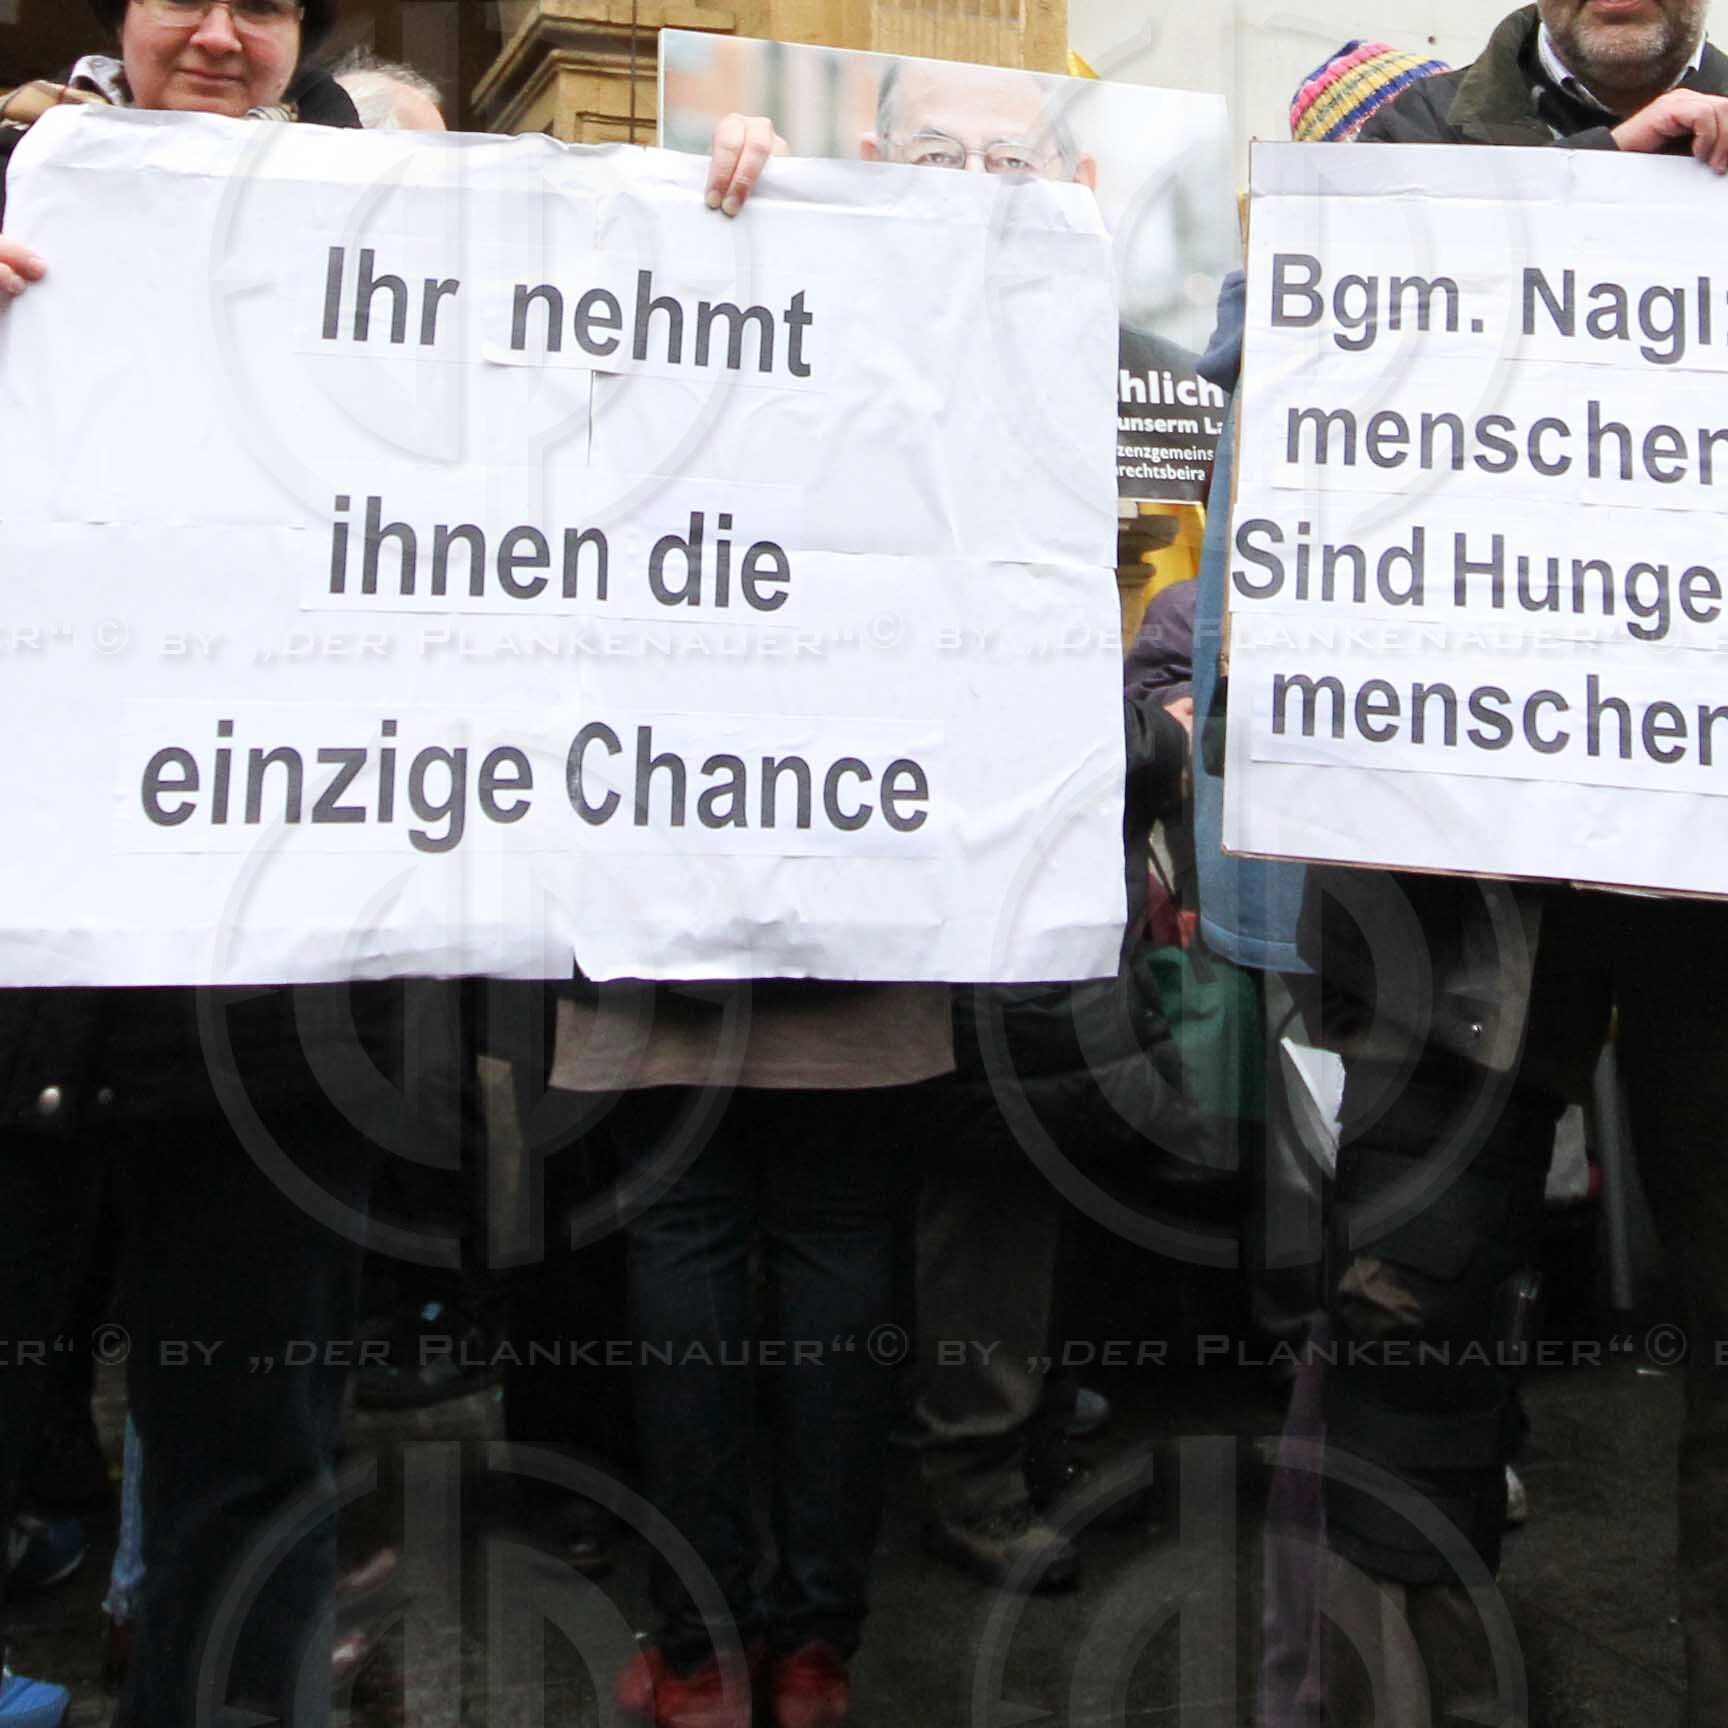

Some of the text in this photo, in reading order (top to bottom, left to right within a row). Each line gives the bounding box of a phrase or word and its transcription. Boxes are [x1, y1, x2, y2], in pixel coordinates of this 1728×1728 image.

[322, 246, 813, 378] Ihr nehmt
[1270, 254, 1484, 350] Bgm.
[1116, 369, 1225, 408] hlich
[1118, 417, 1199, 434] unserm
[330, 495, 792, 612] ihnen die
[1232, 518, 1426, 607] Sind
[142, 719, 930, 853] einzige Chance
